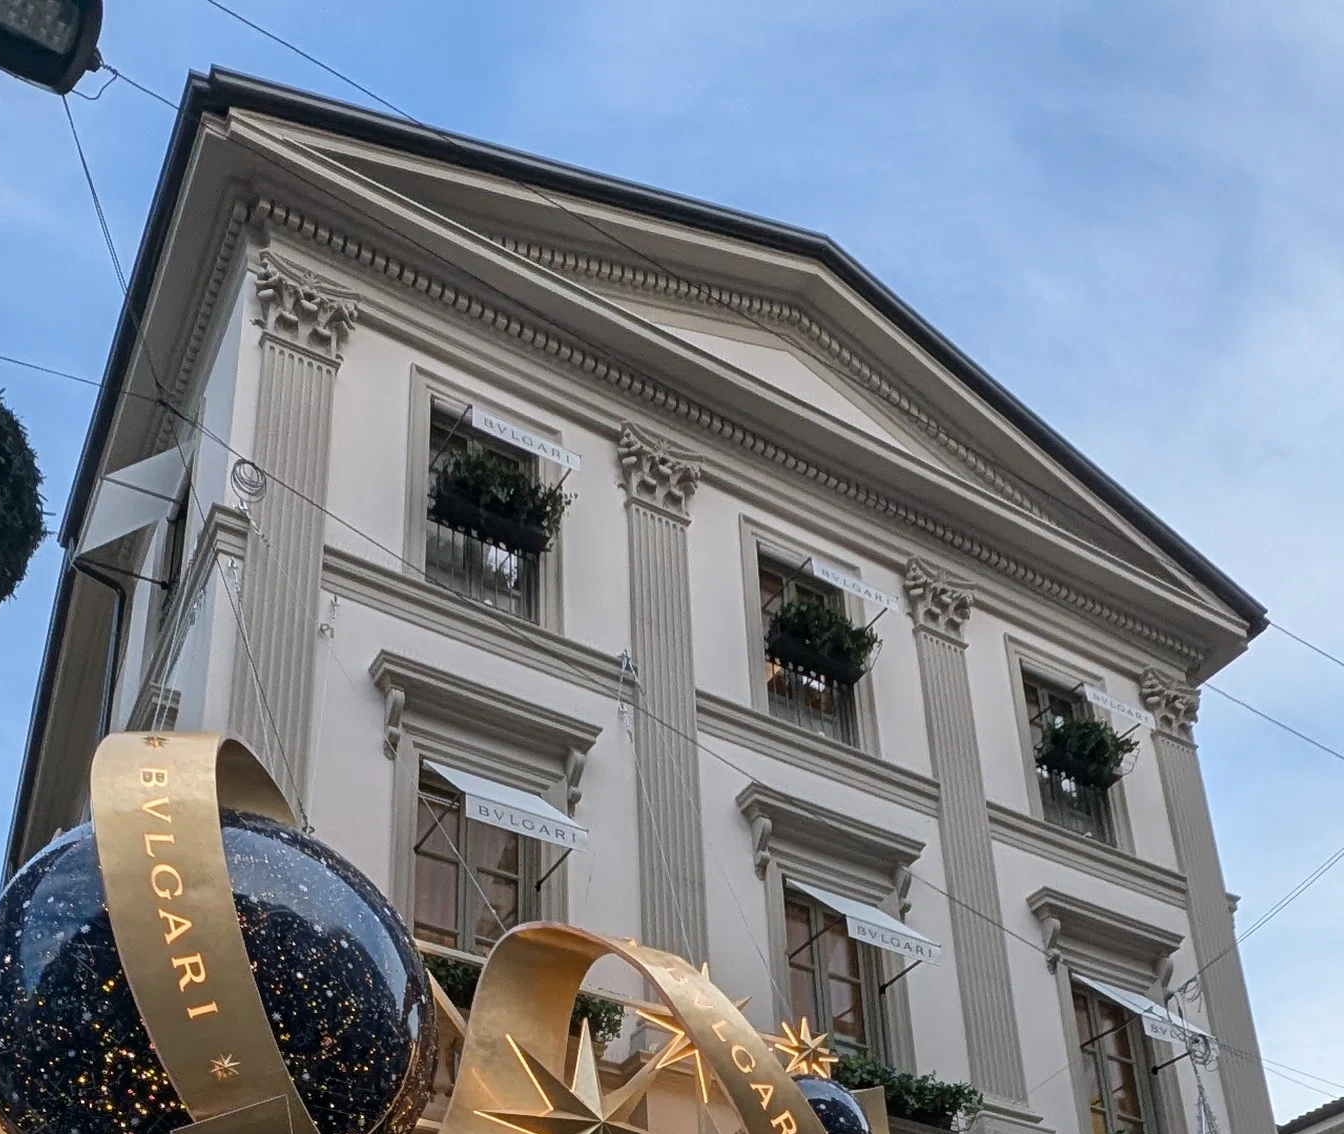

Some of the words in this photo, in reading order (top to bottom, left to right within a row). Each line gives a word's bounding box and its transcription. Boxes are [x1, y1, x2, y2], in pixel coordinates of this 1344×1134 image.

[483, 417, 571, 464] BVLGARI
[478, 804, 577, 843] BVLGARI
[139, 766, 219, 1020] BVLGARI
[856, 925, 932, 958] BVLGARI
